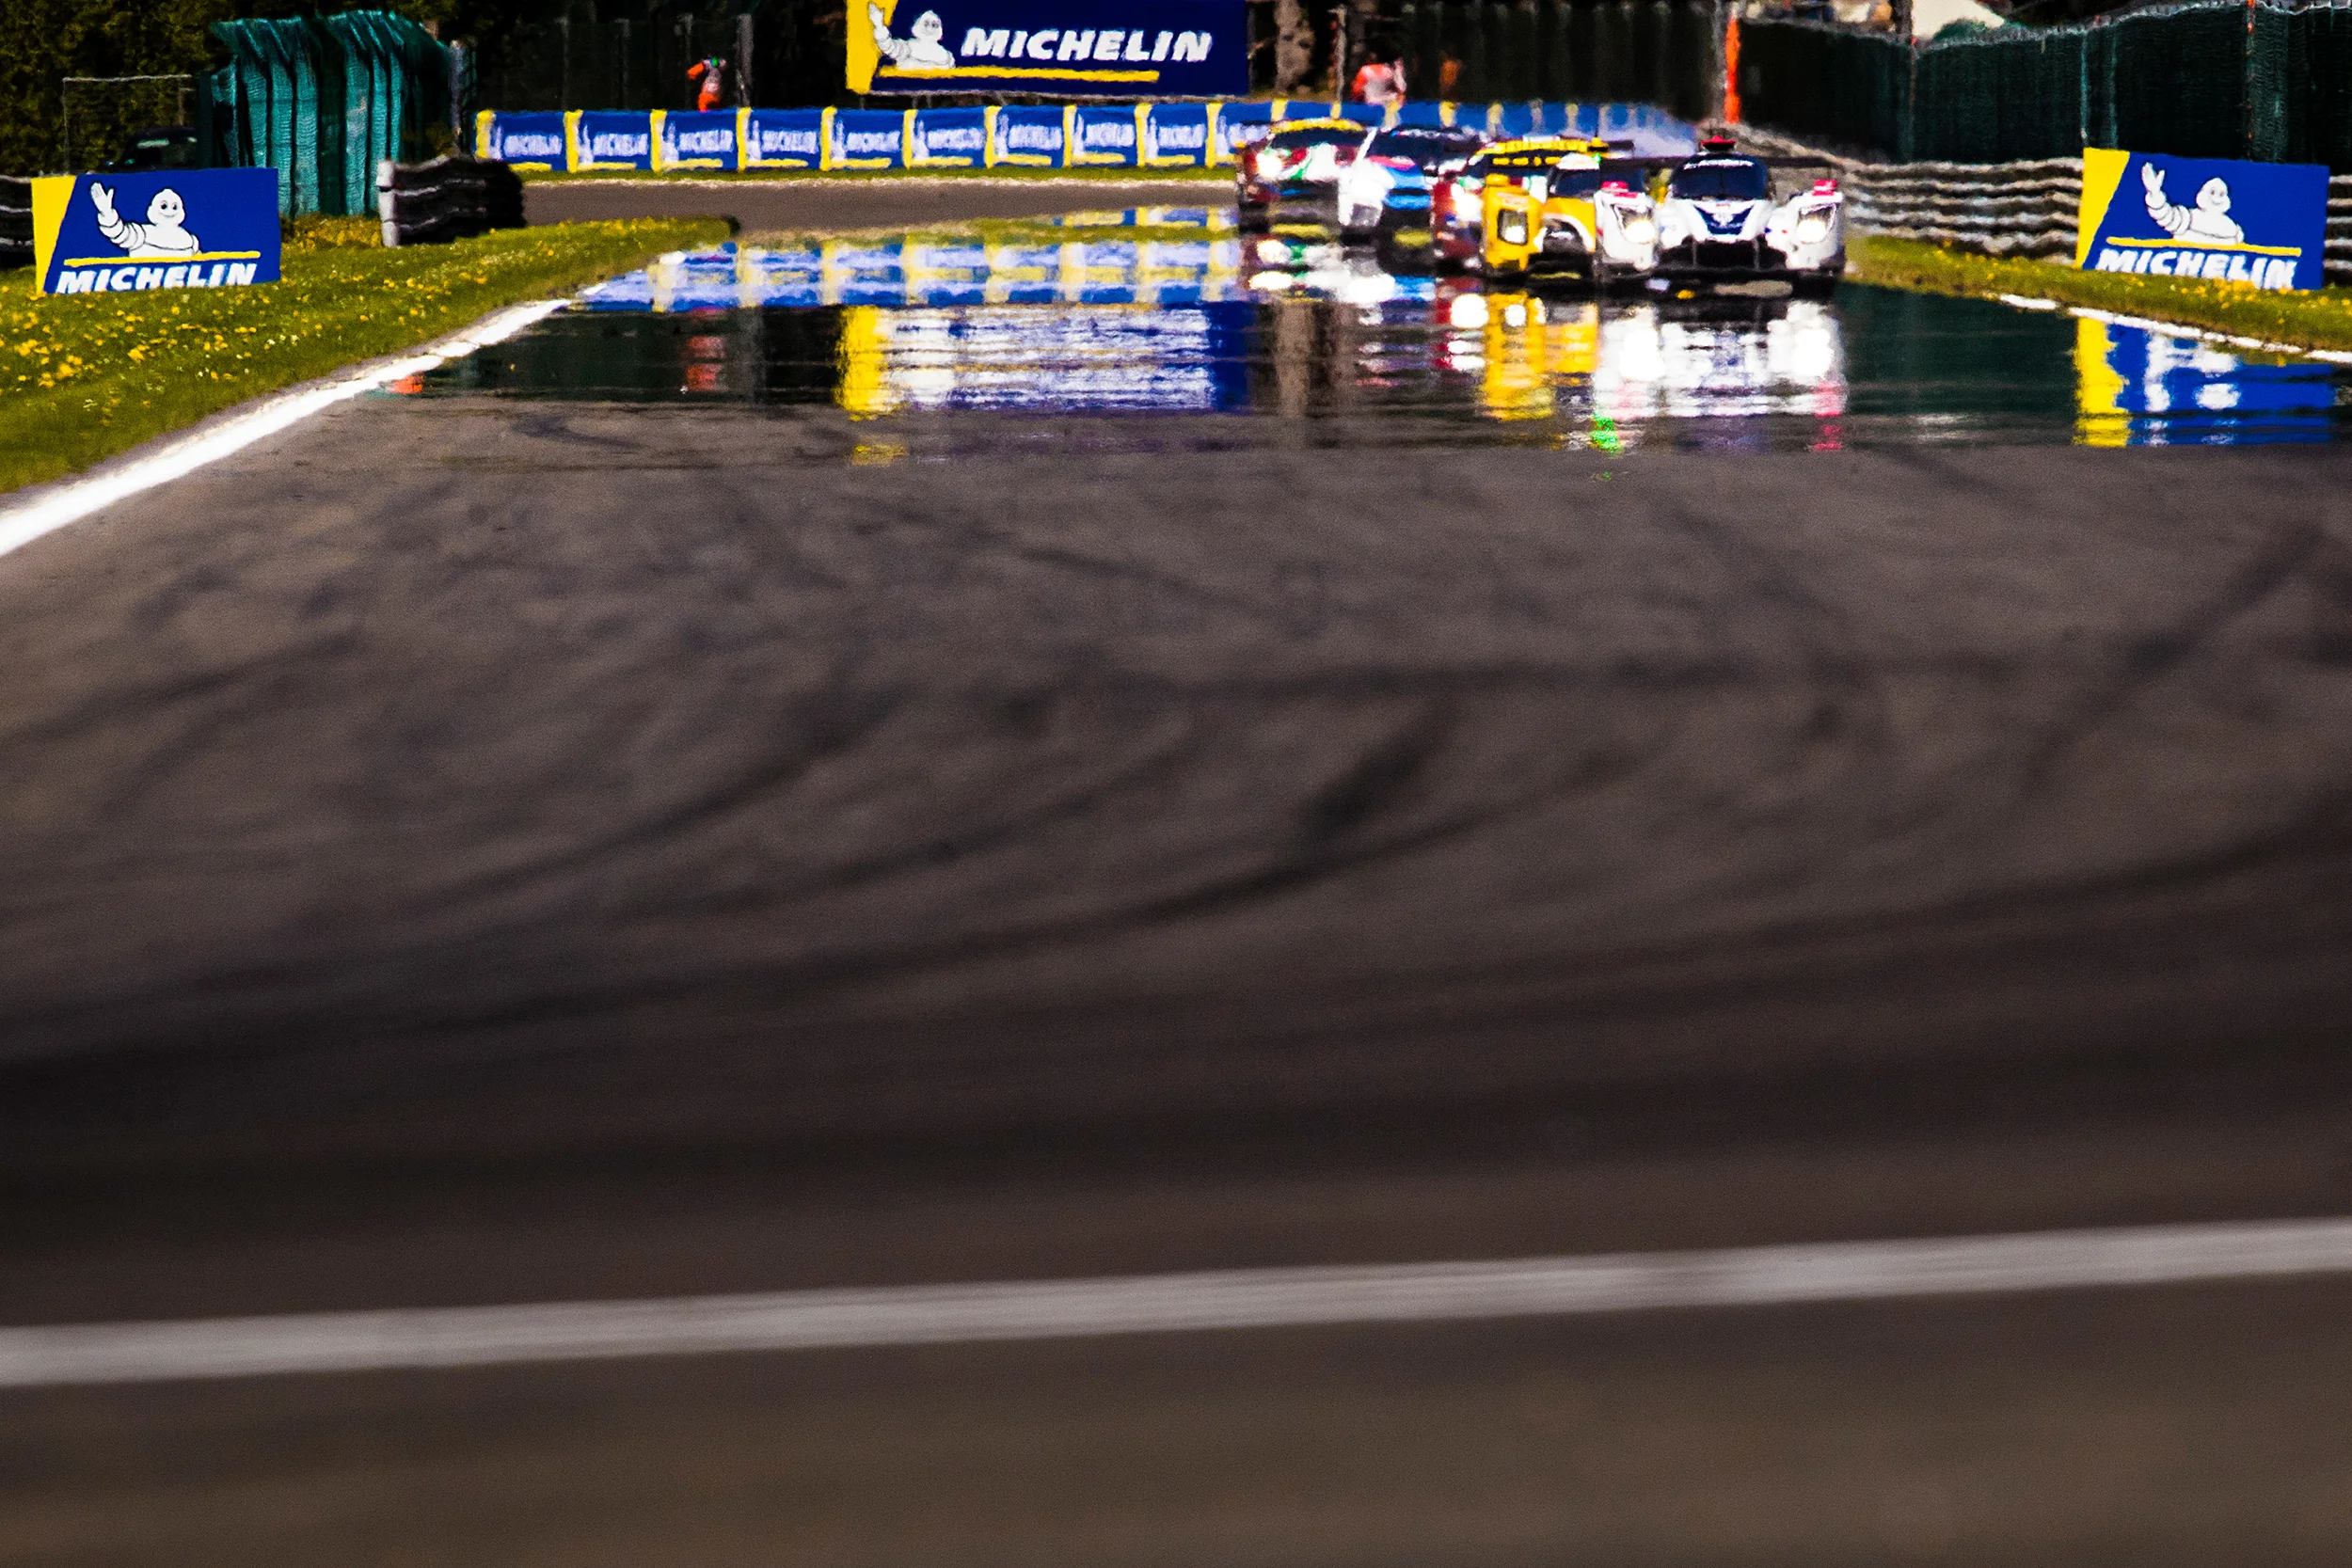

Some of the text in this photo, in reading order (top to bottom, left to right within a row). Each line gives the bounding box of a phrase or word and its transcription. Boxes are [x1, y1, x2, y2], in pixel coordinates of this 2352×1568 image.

[961, 26, 1214, 62] MICHELIN
[55, 262, 257, 294] MICHELIN
[2094, 248, 2297, 290] MICHELIN
